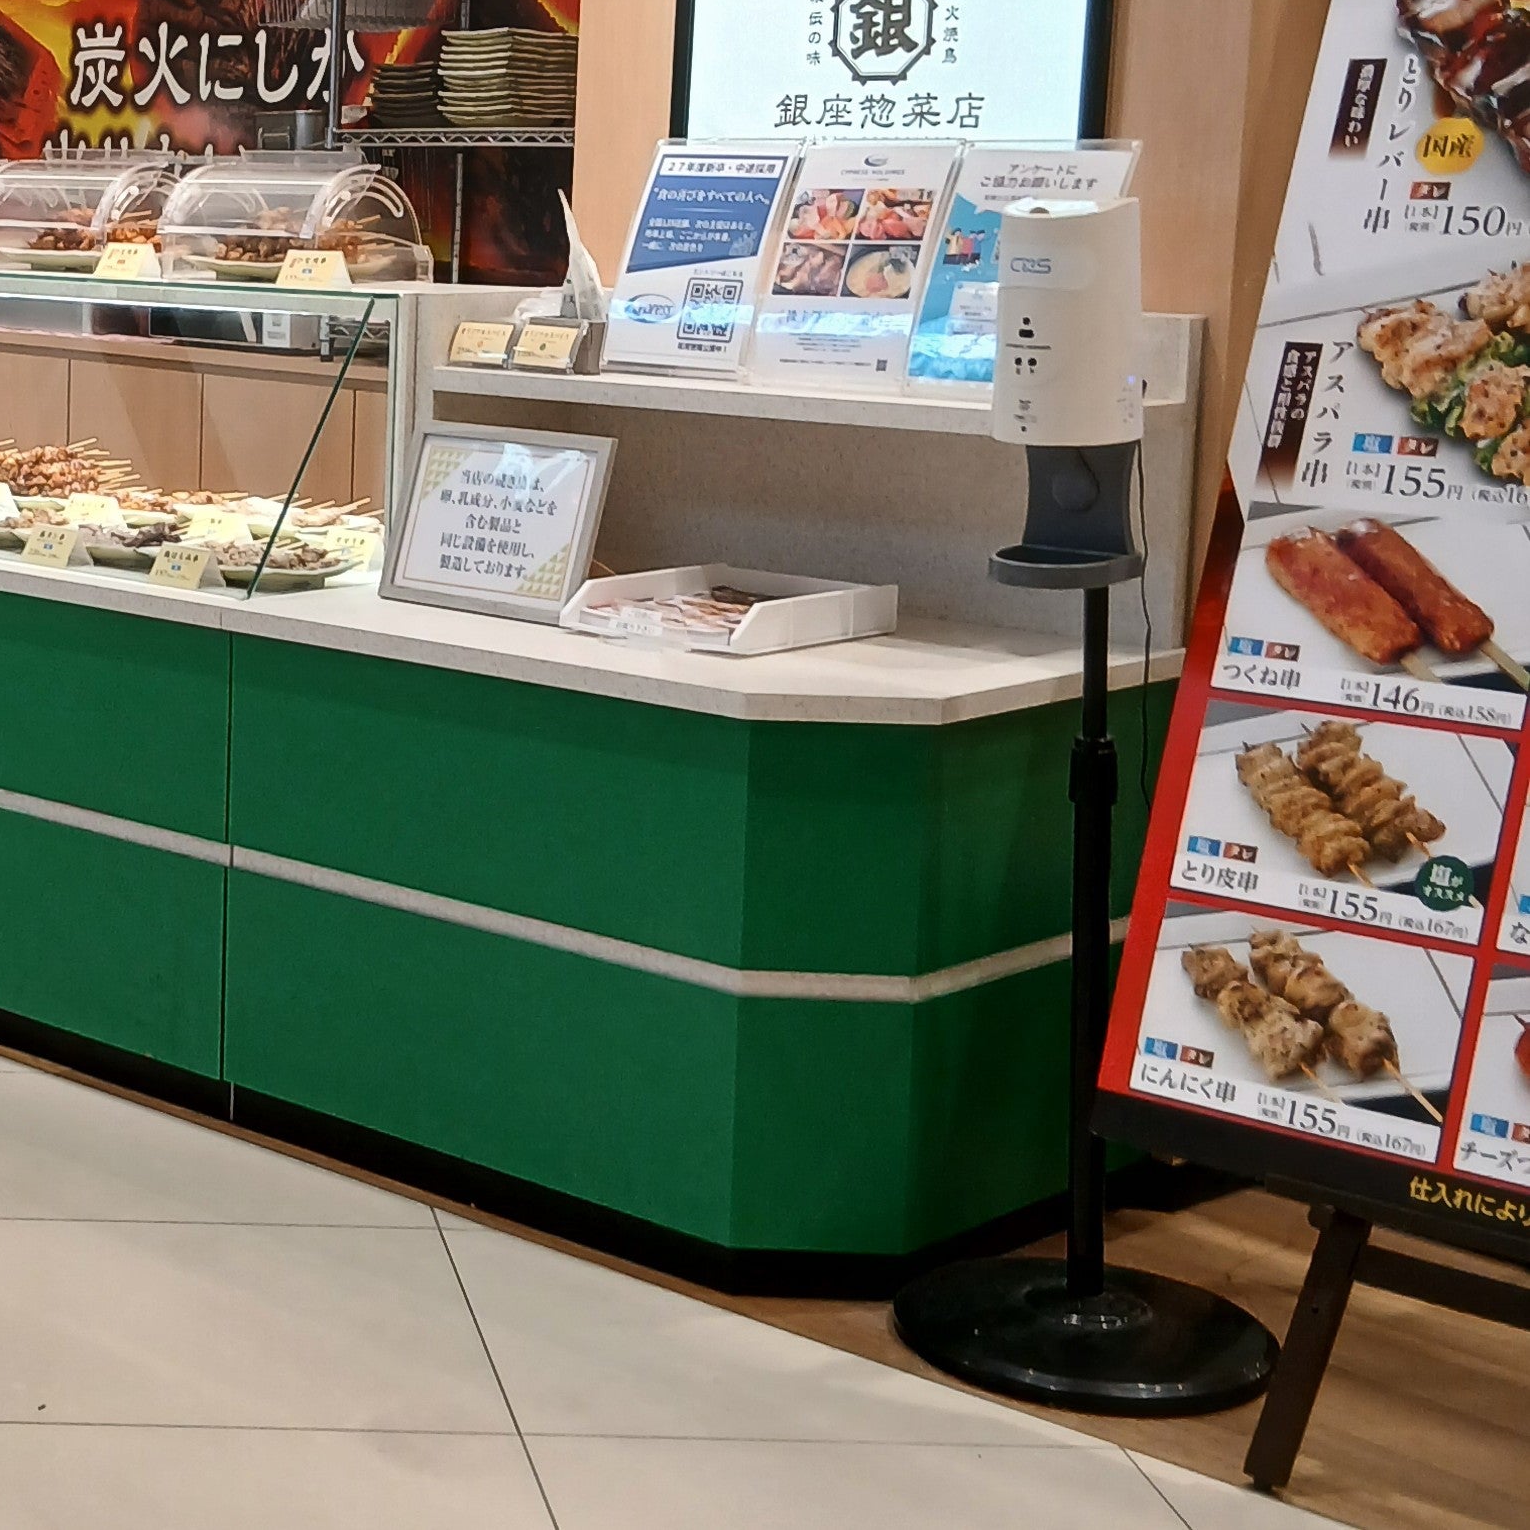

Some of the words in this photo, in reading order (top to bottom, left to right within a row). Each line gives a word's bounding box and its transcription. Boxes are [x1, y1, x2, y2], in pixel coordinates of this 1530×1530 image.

[69, 21, 367, 110] 炭火にしか
[773, 91, 986, 131] 銀座惣菜店
[1301, 340, 1355, 488] アスパラ串
[1181, 860, 1260, 895] とり皮串
[1140, 1063, 1237, 1104] にんにく串
